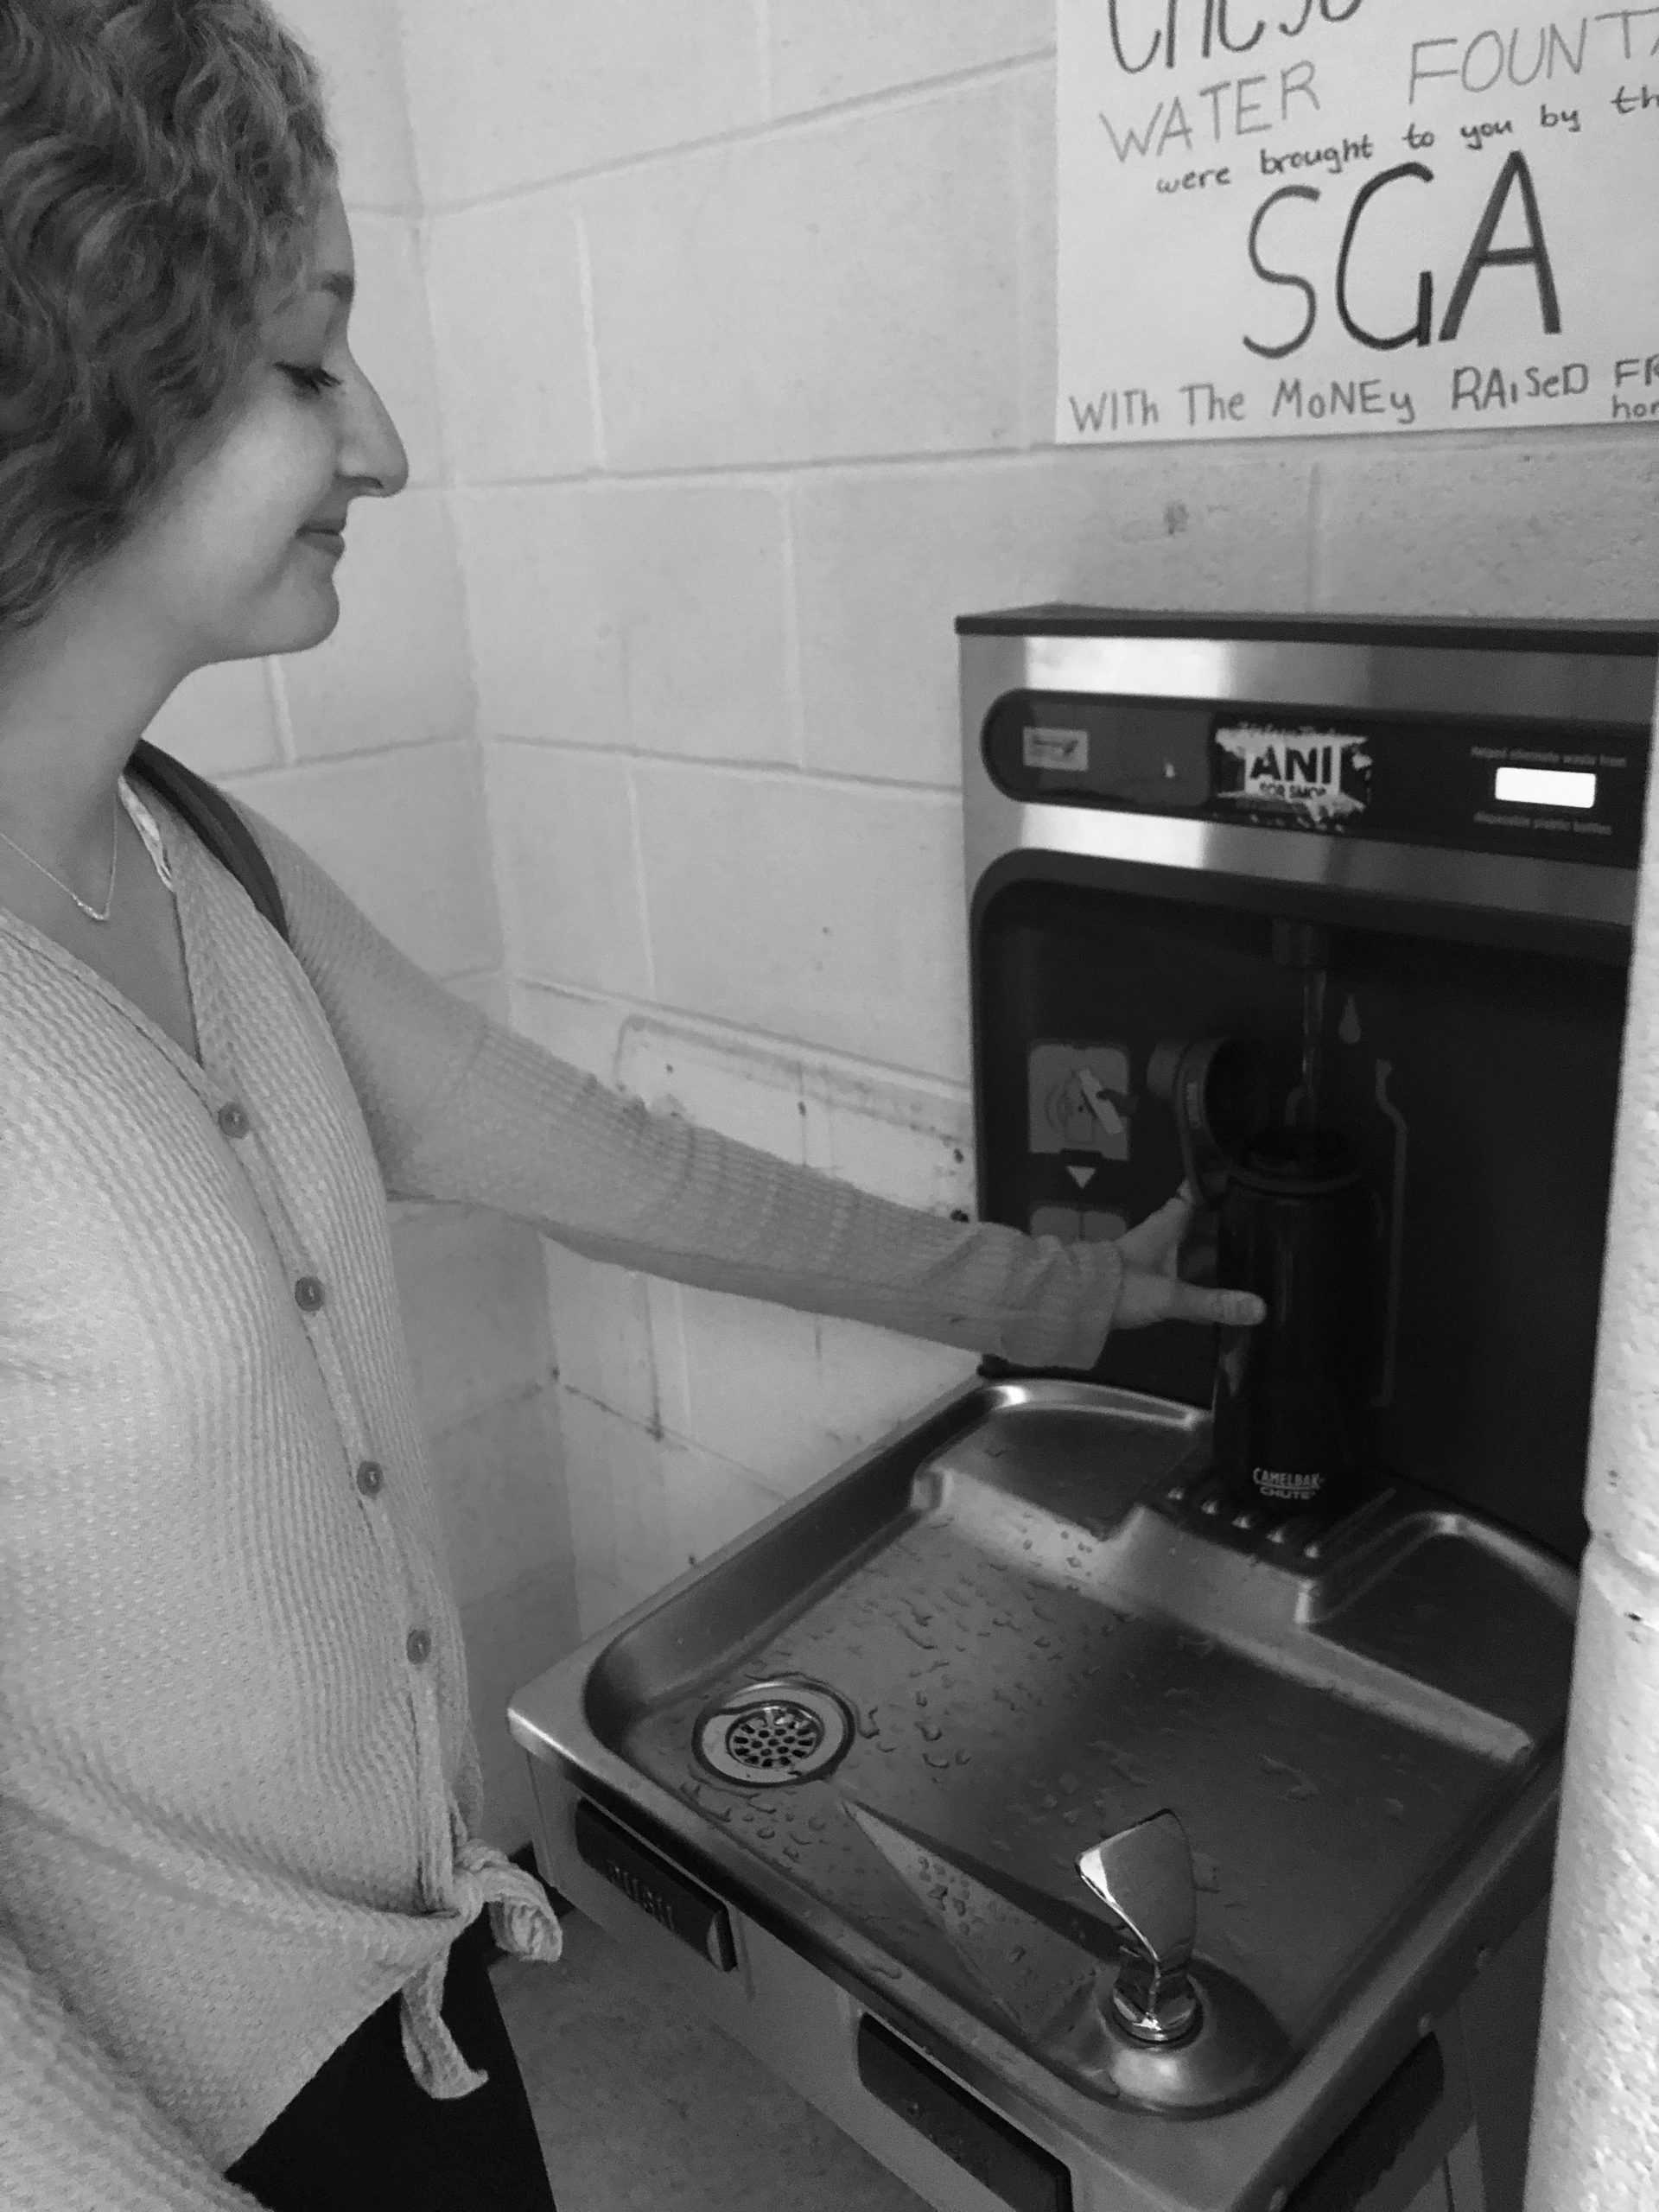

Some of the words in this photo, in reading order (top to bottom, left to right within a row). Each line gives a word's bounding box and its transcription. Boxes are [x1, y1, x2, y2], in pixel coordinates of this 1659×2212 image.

[1099, 60, 1320, 163] WATER
[1156, 166, 1231, 194] were
[1260, 134, 1374, 175] brought
[1402, 123, 1435, 150] to
[1459, 119, 1513, 150] you
[1540, 104, 1580, 132] by
[1243, 150, 1562, 360] SGA
[1179, 383, 1245, 425] The
[1252, 1466, 1321, 1488] CAMELBAK
